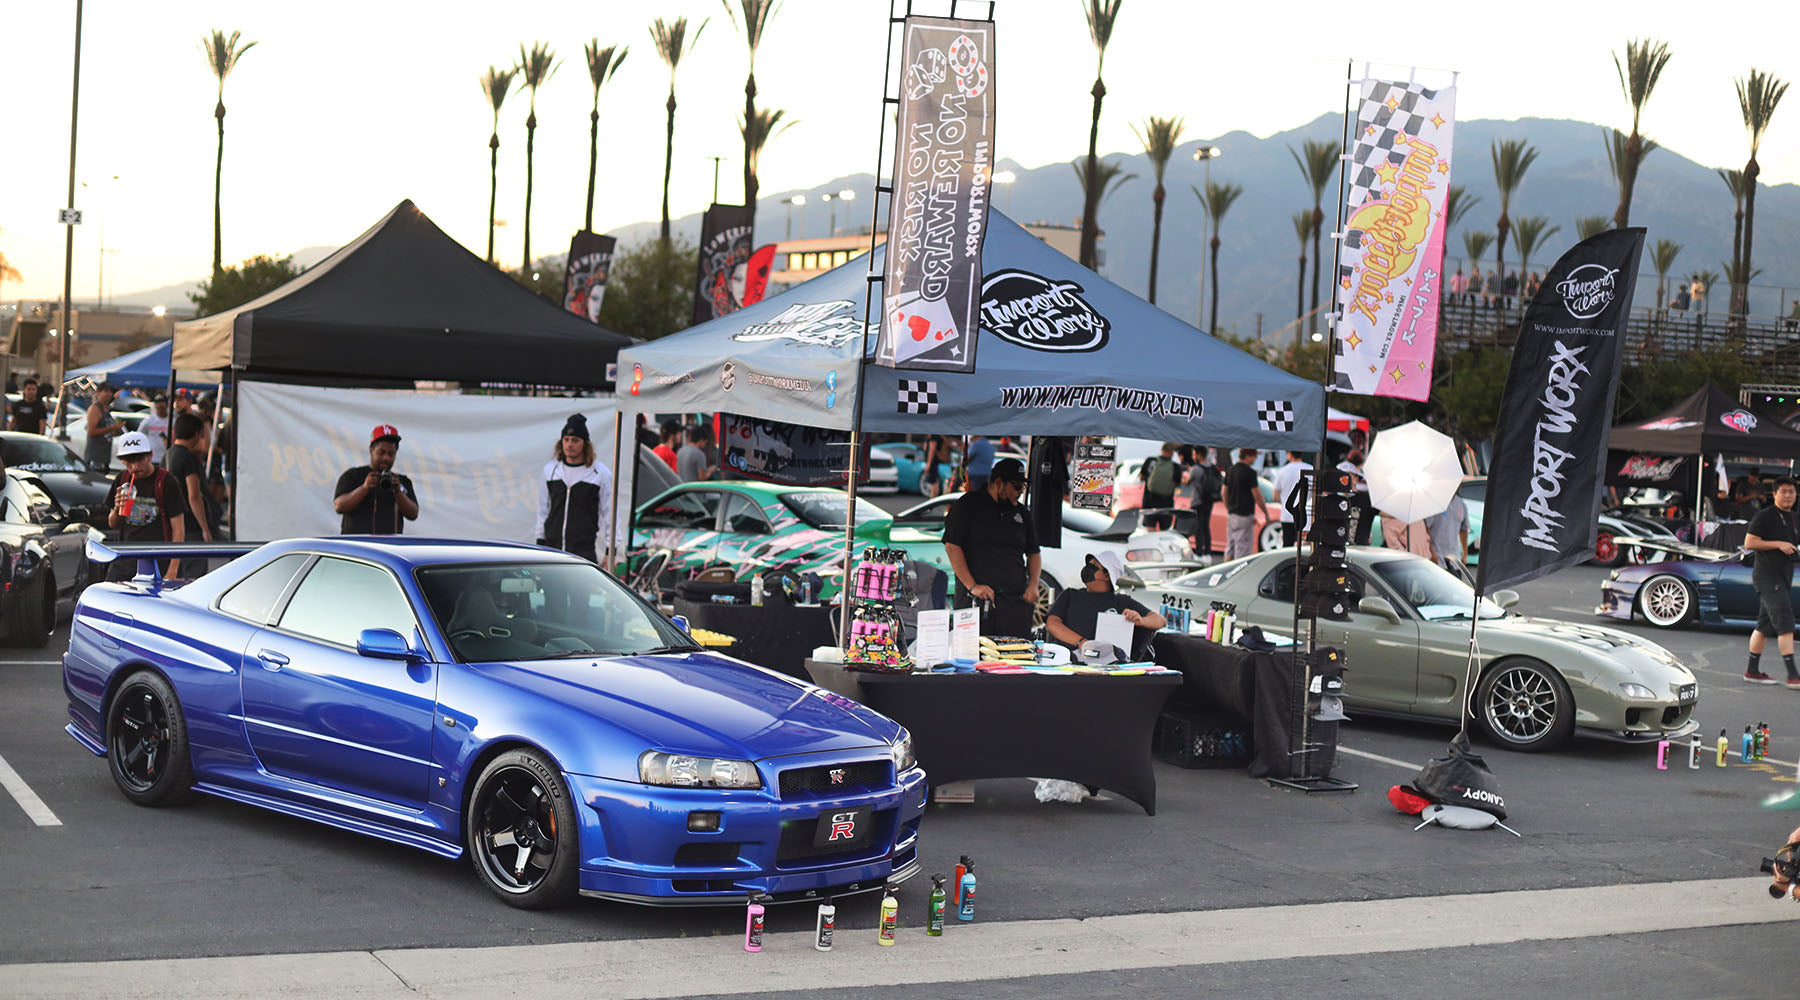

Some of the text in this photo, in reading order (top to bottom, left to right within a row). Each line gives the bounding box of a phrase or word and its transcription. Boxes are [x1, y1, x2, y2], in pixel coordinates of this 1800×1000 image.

[1556, 269, 1619, 300] Import
[1572, 289, 1615, 312] Worx
[1000, 385, 1204, 422] WWW.IMPORTWORX.COM
[1518, 340, 1592, 553] IMPORT WORX
[528, 757, 562, 798] MICHELIN
[1462, 787, 1504, 807] CANOPY
[831, 811, 859, 823] GT
[829, 821, 855, 841] R
